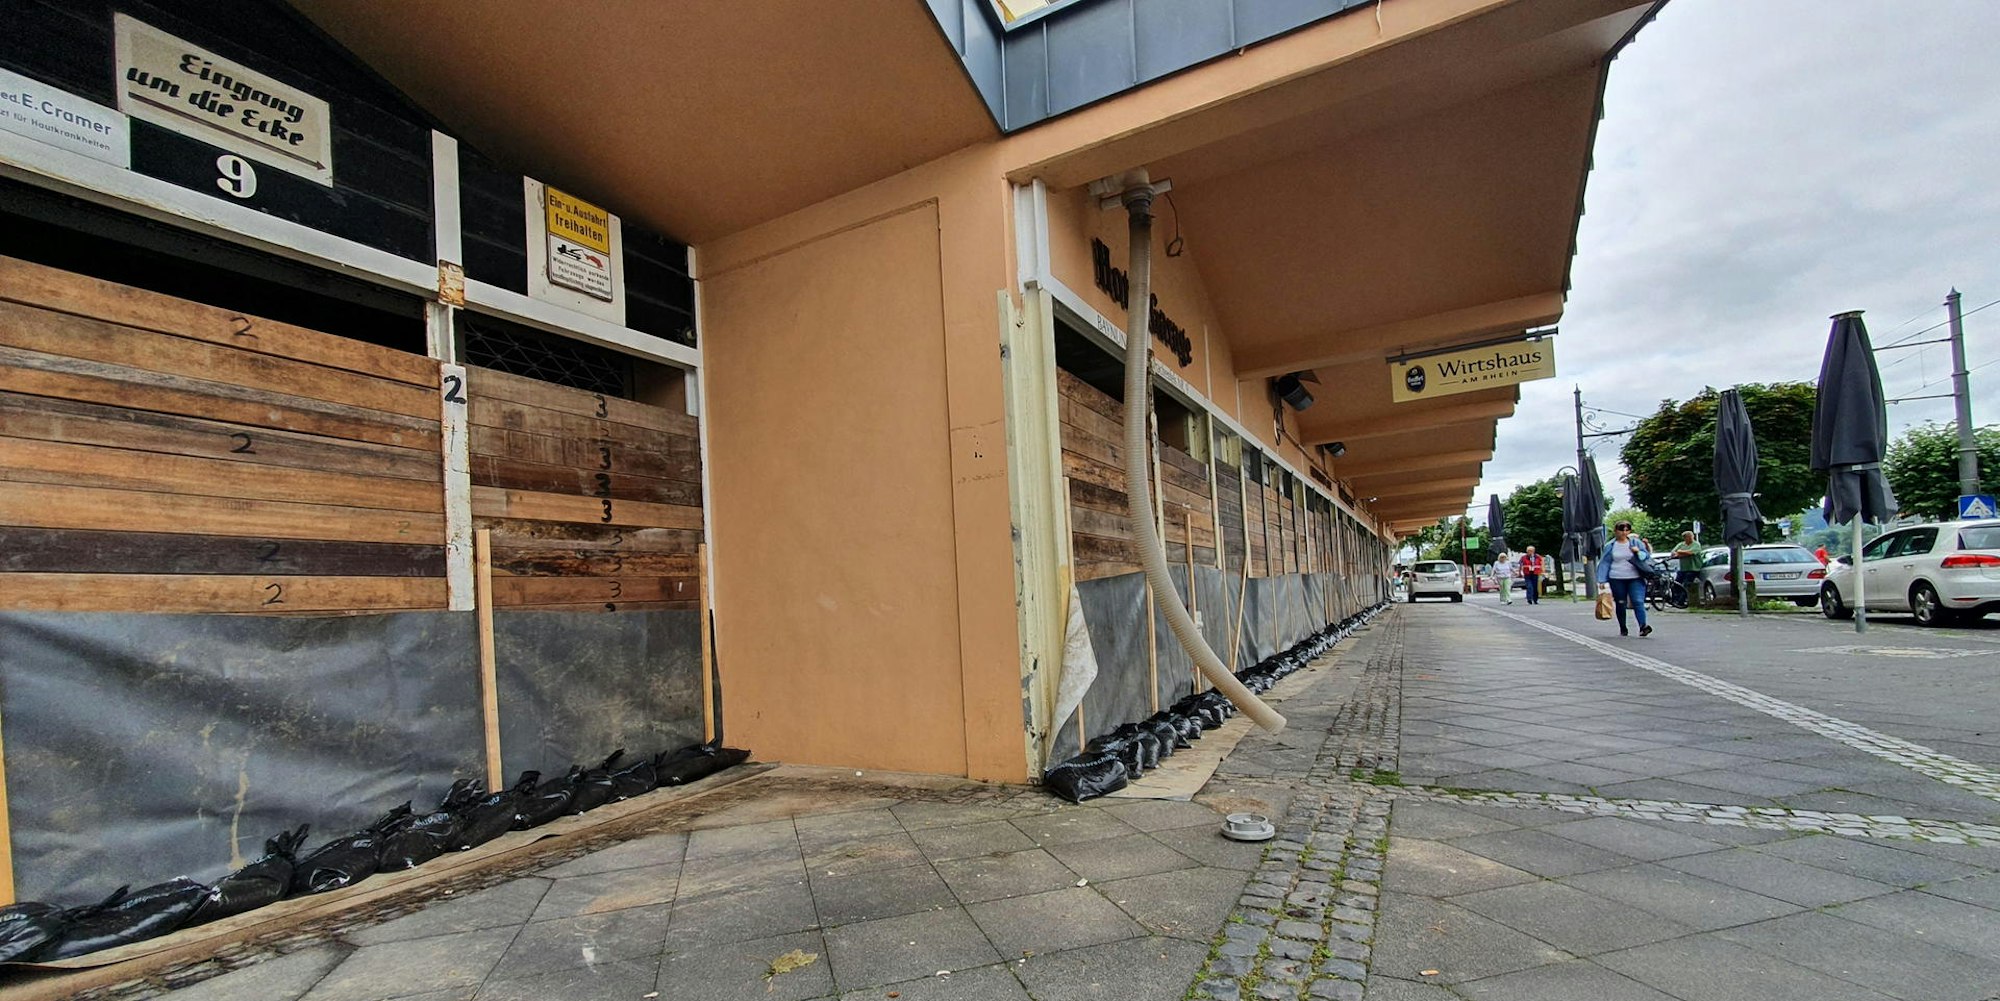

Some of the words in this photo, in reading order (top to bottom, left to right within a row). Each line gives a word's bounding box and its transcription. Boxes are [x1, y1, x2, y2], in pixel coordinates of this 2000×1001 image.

[178, 53, 304, 123] Eingang
[0, 91, 21, 105] ed.
[41, 101, 112, 136] Cramer
[126, 67, 181, 98] um
[188, 90, 234, 118] die
[240, 109, 304, 146] Ecke
[13, 112, 27, 123] für
[31, 118, 111, 151] Hautkrankheiten
[215, 153, 258, 199] 9
[555, 212, 603, 243] freihalten
[573, 205, 606, 228] Ausfahrt
[230, 316, 259, 340] 2
[1437, 352, 1542, 378] Wirtshaus
[1462, 376, 1478, 384] AM
[1482, 370, 1518, 381] RHEIN
[443, 375, 467, 405] 2
[593, 394, 608, 419] 3
[230, 432, 257, 455] 2
[599, 447, 612, 470] 3
[602, 499, 612, 522] 3
[398, 520, 411, 534] 2
[255, 541, 284, 562] 2
[262, 583, 284, 606] 2
[608, 581, 622, 598] 3
